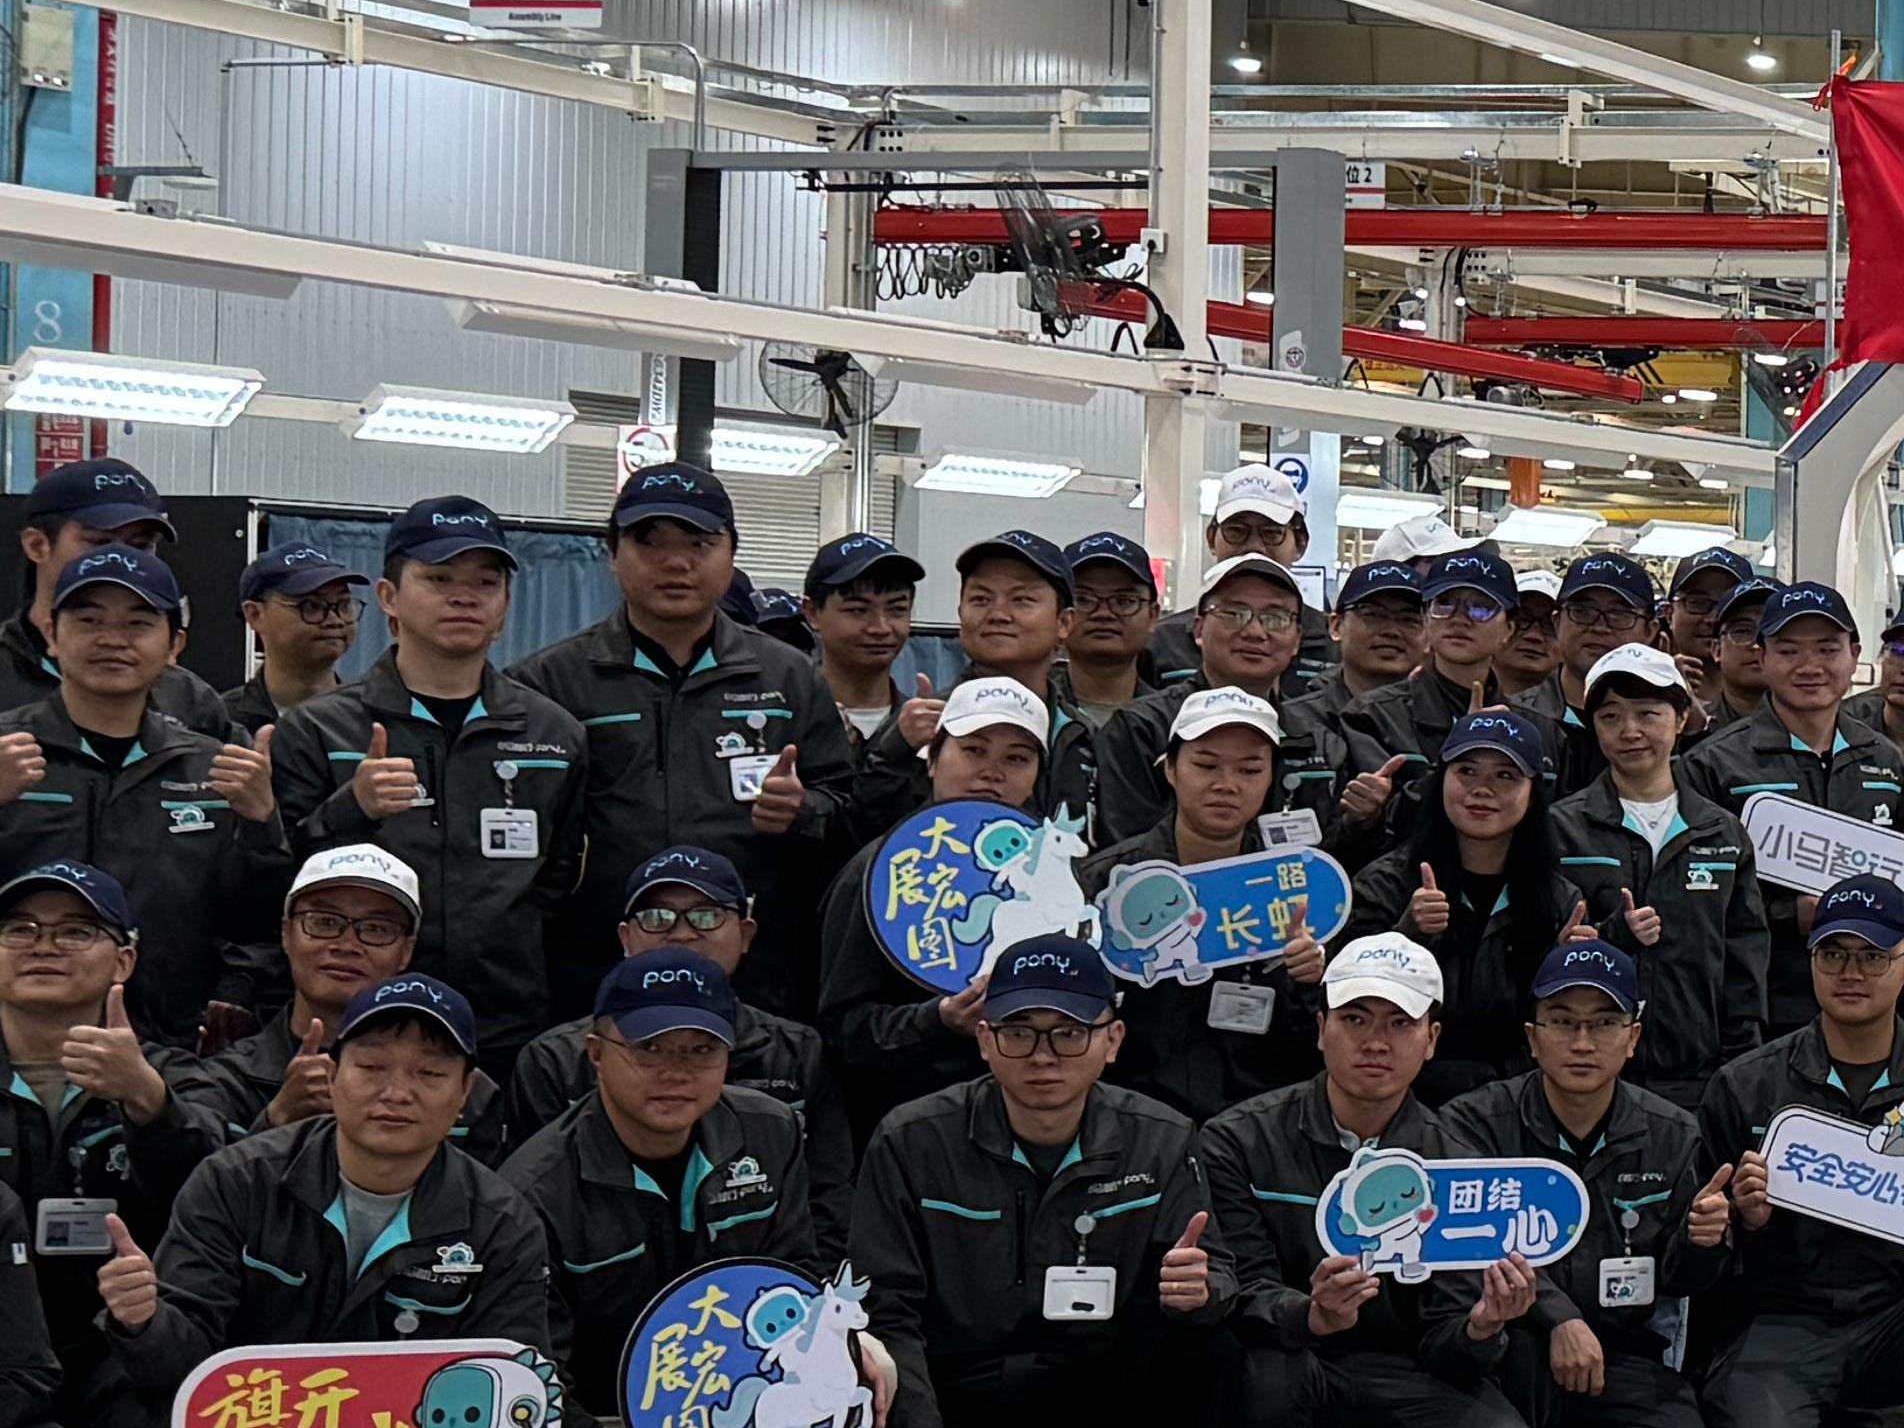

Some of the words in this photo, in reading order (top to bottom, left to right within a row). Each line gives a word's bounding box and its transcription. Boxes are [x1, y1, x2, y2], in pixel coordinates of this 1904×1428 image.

[33, 300, 62, 343] 8
[1759, 824, 1904, 879] 小马智行
[1245, 861, 1307, 892] 一路
[1448, 1178, 1524, 1216] 团结
[1440, 1205, 1559, 1256] 一心
